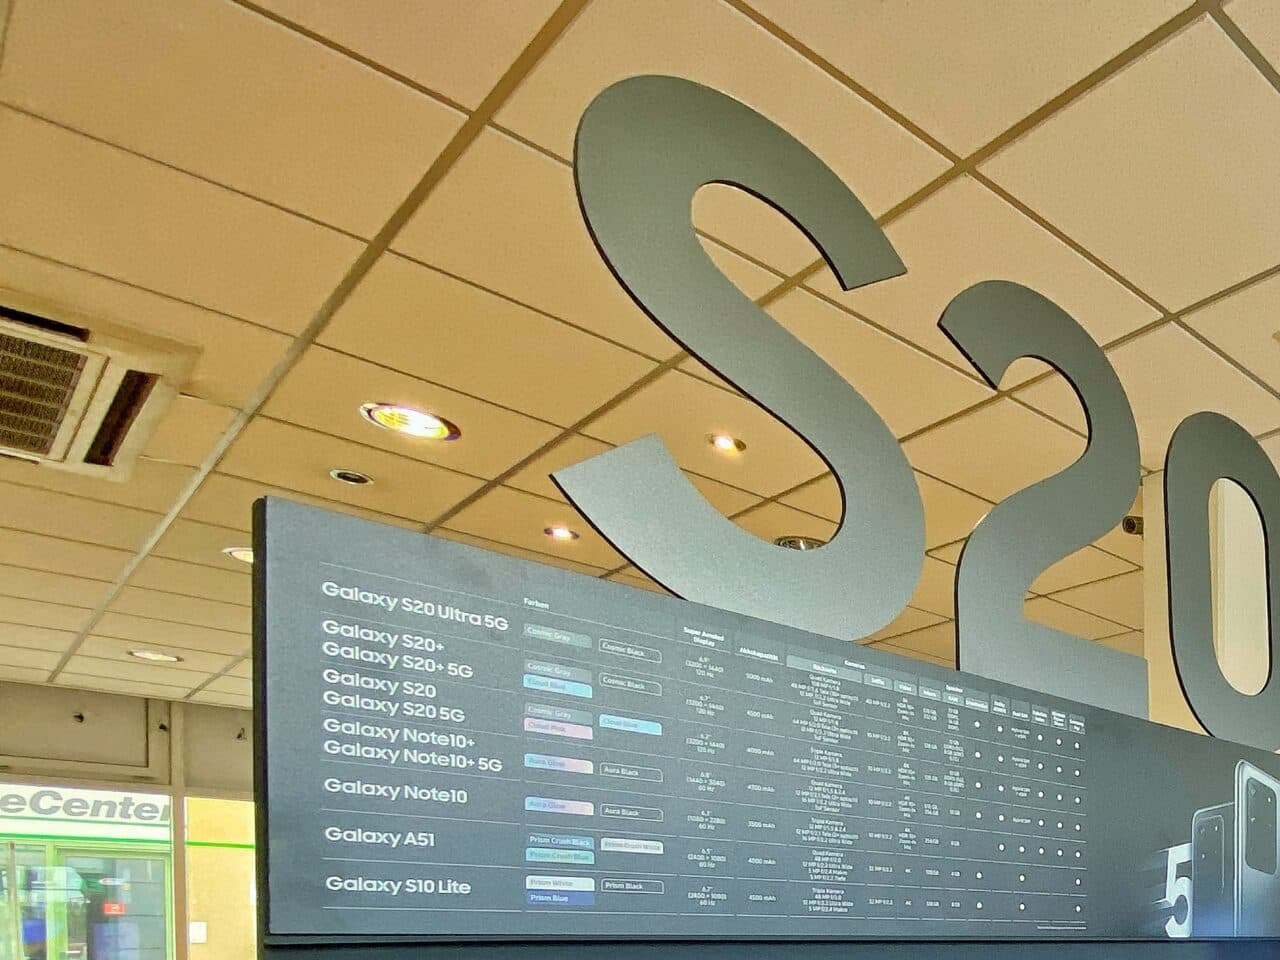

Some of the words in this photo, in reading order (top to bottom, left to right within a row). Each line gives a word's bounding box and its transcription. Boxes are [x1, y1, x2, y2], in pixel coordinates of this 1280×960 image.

[322, 582, 398, 611] Galaxy
[402, 598, 434, 616] S20
[438, 605, 482, 625] Ultra
[484, 615, 509, 631] 5G
[322, 620, 398, 648] Galaxy
[402, 634, 444, 652] S20+
[527, 626, 553, 638] Cosmic
[554, 632, 570, 643] Gray
[322, 641, 398, 669] Galaxy
[402, 655, 444, 672] S20+
[448, 663, 473, 678] 5G
[602, 642, 626, 653] Cosmic
[627, 646, 644, 657] Black
[528, 662, 553, 673] Cosmic
[554, 668, 571, 678] Gray
[602, 676, 626, 686] Cosmic
[322, 669, 400, 696] Galaxy
[402, 681, 436, 698] S20
[322, 690, 400, 717] Galaxy
[402, 702, 436, 718] S20
[440, 708, 466, 723] 5G
[324, 718, 400, 742] Galaxy
[404, 728, 475, 748] Note10+
[324, 740, 400, 764] Galaxy
[404, 748, 475, 768] Note10+
[478, 758, 502, 772] 5G
[604, 766, 620, 774] Aura
[621, 768, 638, 776] Black
[324, 778, 400, 801] Galaxy
[404, 784, 468, 804] Note10
[324, 826, 401, 848] Galaxy
[404, 832, 436, 847] A51
[530, 836, 550, 844] Prism
[326, 876, 401, 896] Galaxy
[406, 879, 434, 894] S10
[438, 878, 472, 894] Lite
[605, 882, 624, 890] Prism
[626, 882, 644, 890] Black
